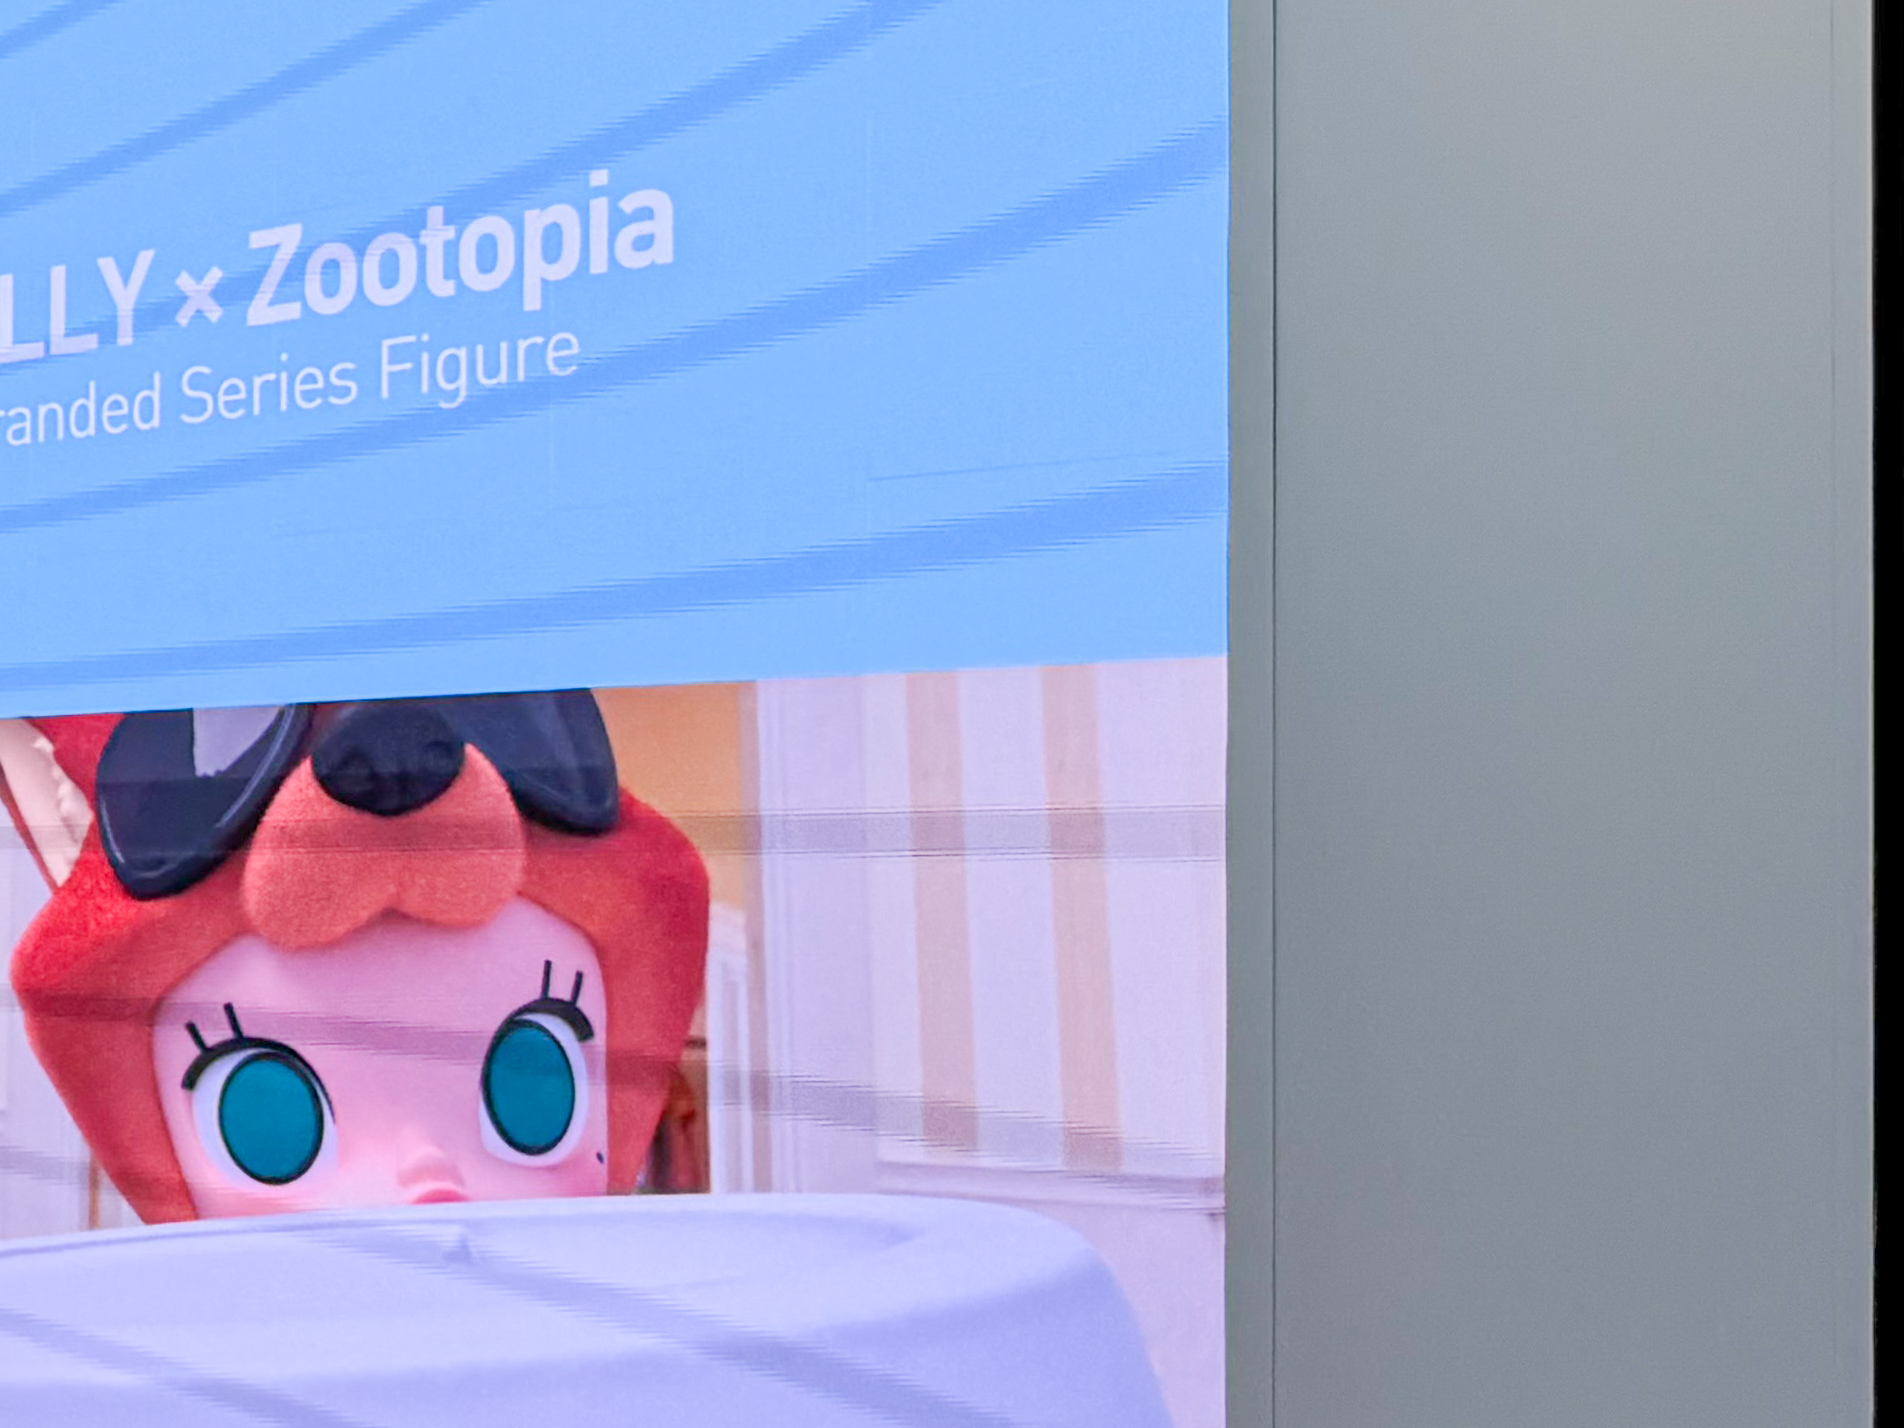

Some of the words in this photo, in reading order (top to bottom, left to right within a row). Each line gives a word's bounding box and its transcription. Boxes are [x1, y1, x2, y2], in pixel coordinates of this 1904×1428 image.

[246, 168, 676, 328] Zootopia
[180, 352, 360, 425] Series
[380, 330, 583, 410] Figure
